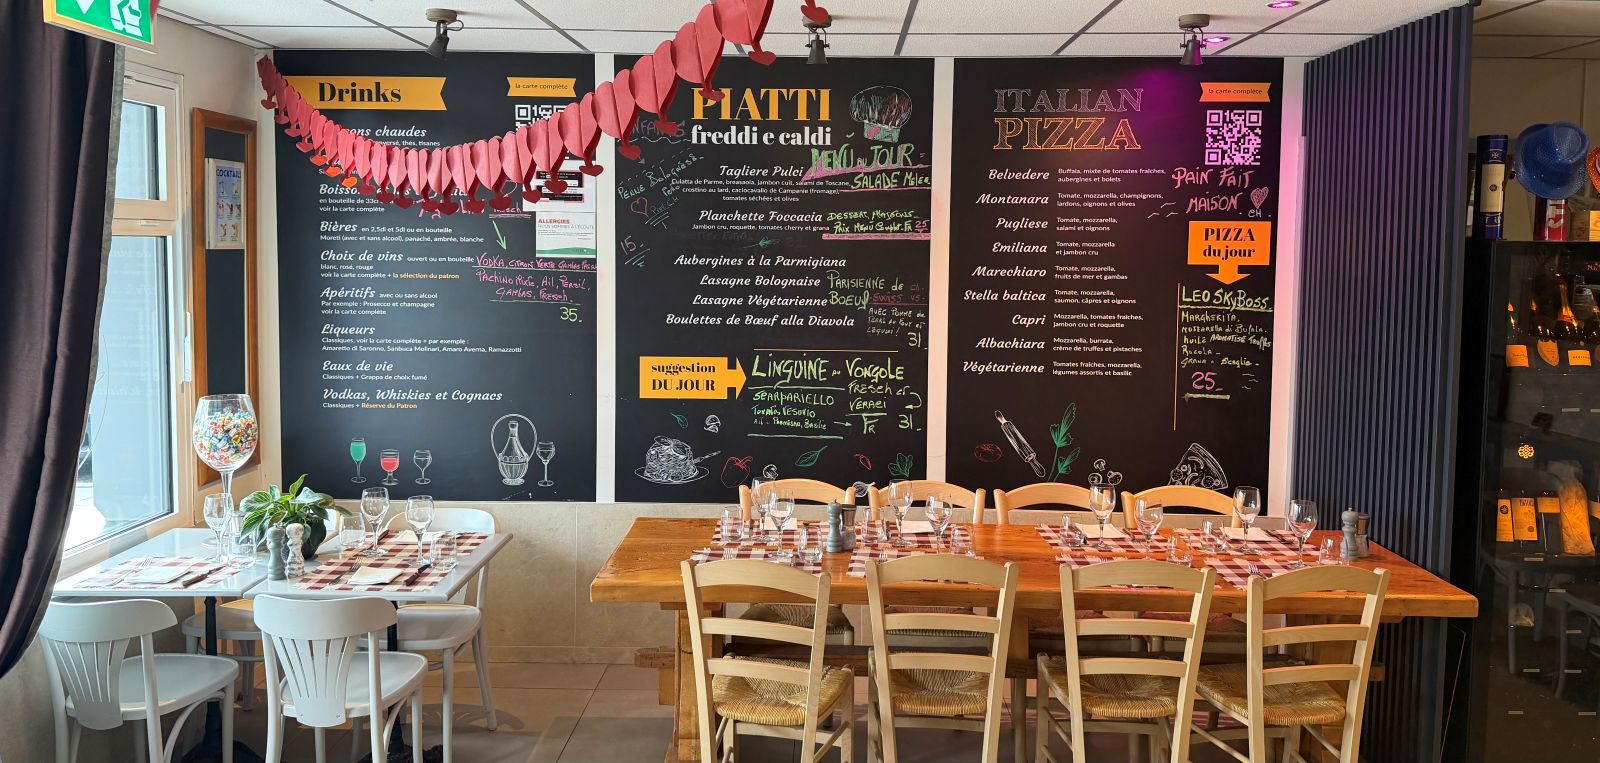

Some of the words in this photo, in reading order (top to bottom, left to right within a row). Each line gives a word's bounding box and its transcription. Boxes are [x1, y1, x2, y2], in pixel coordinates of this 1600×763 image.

[319, 82, 402, 102] Drinks
[691, 88, 831, 121] PIATTI
[994, 89, 1144, 112] ITALIAN
[376, 125, 427, 137] chaudes
[691, 125, 758, 144] freddi
[763, 131, 774, 145] e
[779, 126, 832, 145] caldi
[993, 118, 1142, 151] PIZZA
[866, 143, 914, 169] JOUR
[720, 165, 768, 179] Tagliere
[772, 166, 803, 177] Pulci
[988, 168, 1050, 180] Belvedere
[976, 193, 1049, 204] Montanara
[699, 210, 764, 221] Planchette
[769, 211, 822, 222] Foccacia
[320, 221, 357, 232] Bières
[996, 217, 1048, 231] Pugliese
[1204, 228, 1255, 241] PIZZA
[992, 241, 1048, 253] Emiliana
[1203, 245, 1221, 257] du
[1222, 245, 1255, 260] jour
[320, 250, 355, 261] Choix
[359, 250, 373, 261] de
[378, 251, 403, 261] vins
[674, 255, 743, 268] Aubergines
[748, 255, 755, 266] à
[759, 255, 771, 266] la
[774, 255, 846, 269] Parmigiana
[972, 266, 1047, 277] Marechiaro
[700, 275, 750, 288] Lasagne
[755, 275, 820, 288] Bolognaise
[320, 286, 376, 300] Apéritifs
[964, 290, 998, 301] Stella
[1003, 290, 1046, 301] baltica
[1182, 286, 1210, 302] LEO
[693, 294, 743, 308] Lasagne
[748, 295, 828, 308] Végétarienne
[666, 314, 722, 325] Boulettes
[726, 314, 740, 325] de
[745, 314, 778, 326] Bœuf
[781, 315, 804, 326] alla
[808, 316, 854, 326] Diavola
[1012, 314, 1046, 327] Capri
[321, 324, 376, 337] Liqueurs
[976, 337, 1045, 349] Albachiara
[323, 360, 352, 371] Eaux
[356, 360, 371, 371] de
[375, 361, 394, 371] vie
[652, 362, 716, 375] suggestion
[963, 361, 1045, 374] Végétarienne
[652, 379, 672, 391] DU
[676, 379, 715, 391] JOUR
[323, 388, 370, 401] Vodkas,
[376, 389, 430, 401] Whiskies
[436, 391, 448, 400] et
[452, 390, 502, 403] Cognacs
